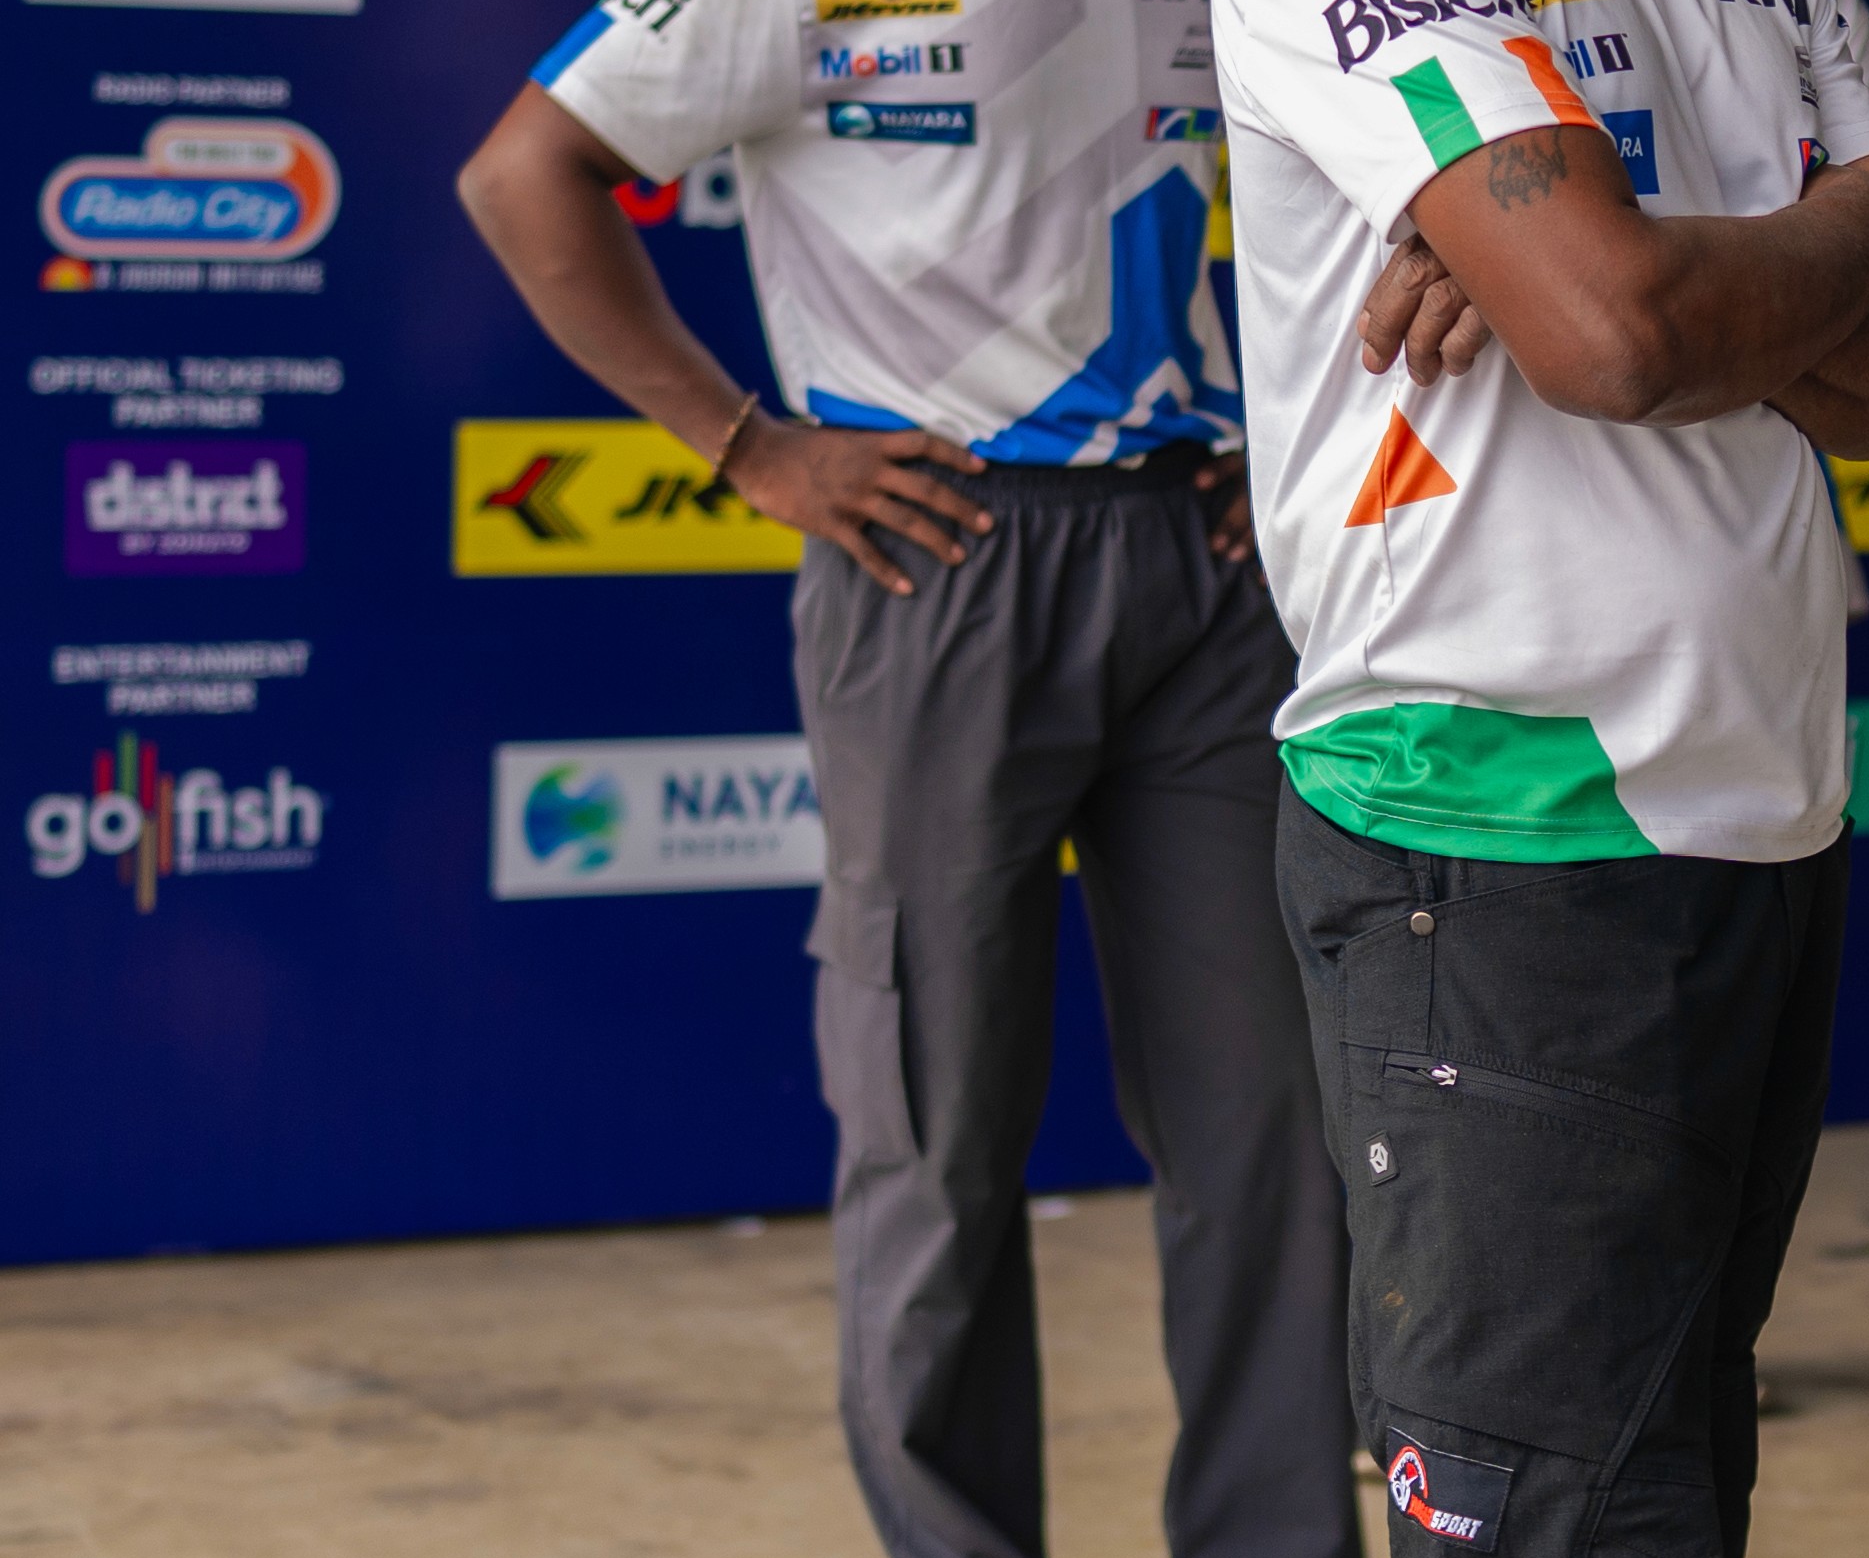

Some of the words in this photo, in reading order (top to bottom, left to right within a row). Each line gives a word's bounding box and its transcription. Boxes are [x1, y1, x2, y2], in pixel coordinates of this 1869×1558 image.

[820, 44, 922, 79] Mobil
[880, 111, 968, 129] NAYARA
[74, 184, 197, 229] Radio
[203, 186, 294, 244] City
[30, 357, 173, 394] OFFICIAL
[181, 357, 343, 394] TICKETING
[1431, 1509, 1484, 1539] SPORT
